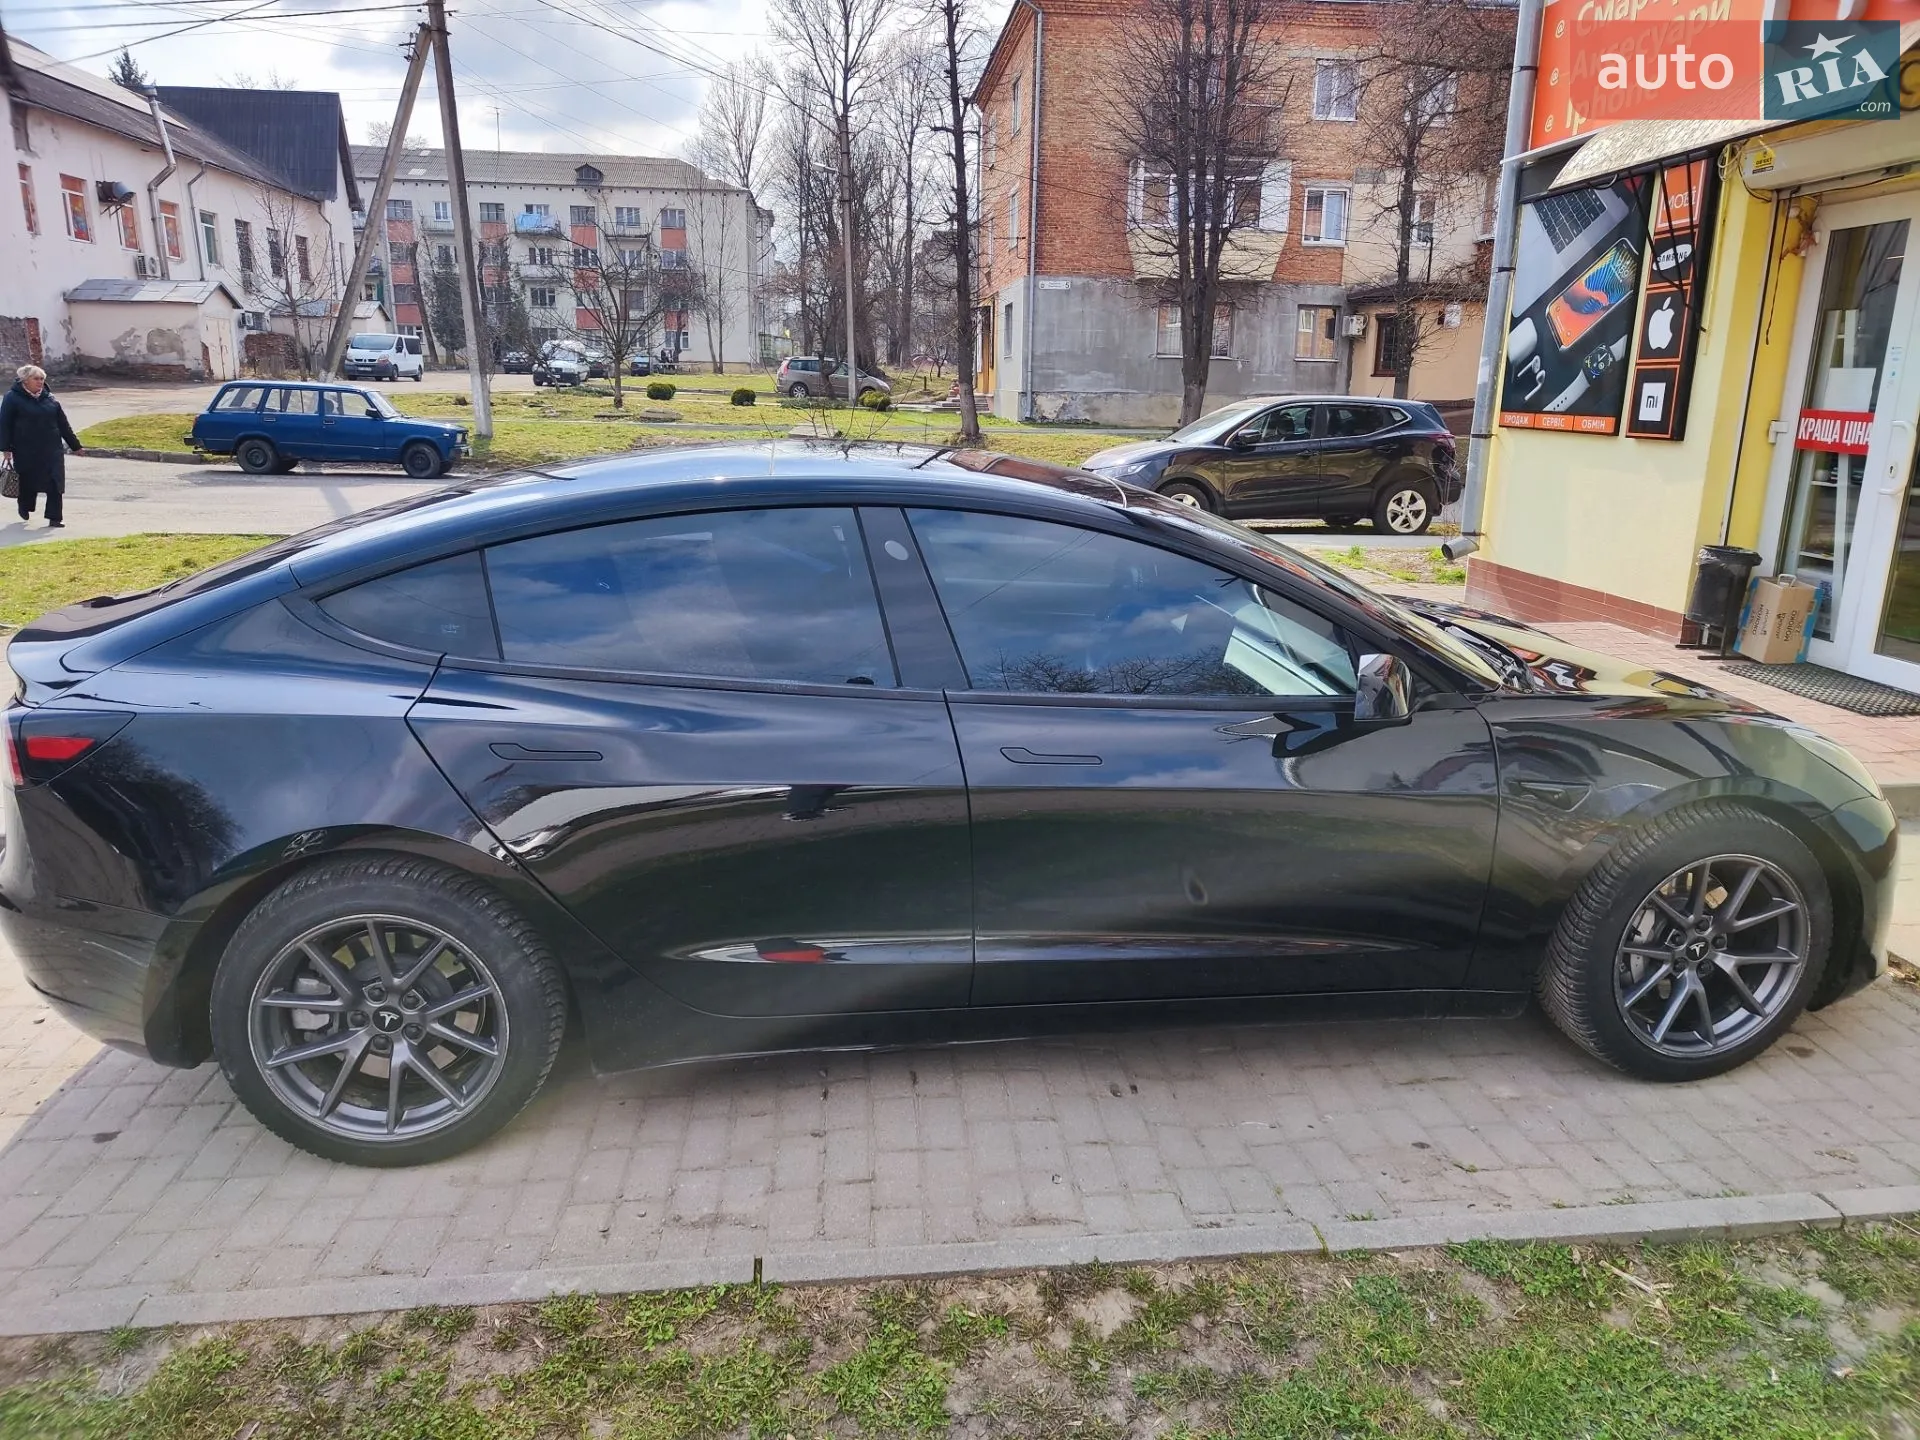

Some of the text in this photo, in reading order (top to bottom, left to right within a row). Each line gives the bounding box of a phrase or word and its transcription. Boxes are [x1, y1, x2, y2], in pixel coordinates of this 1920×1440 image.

[1658, 251, 1688, 262] SAMSNG
[1504, 414, 1529, 425] ПРОДАЖ
[1542, 416, 1565, 428] СЕРВІС
[1581, 418, 1606, 430] ОБМІН
[1798, 417, 1873, 446] КРАЩА ЦІНА
